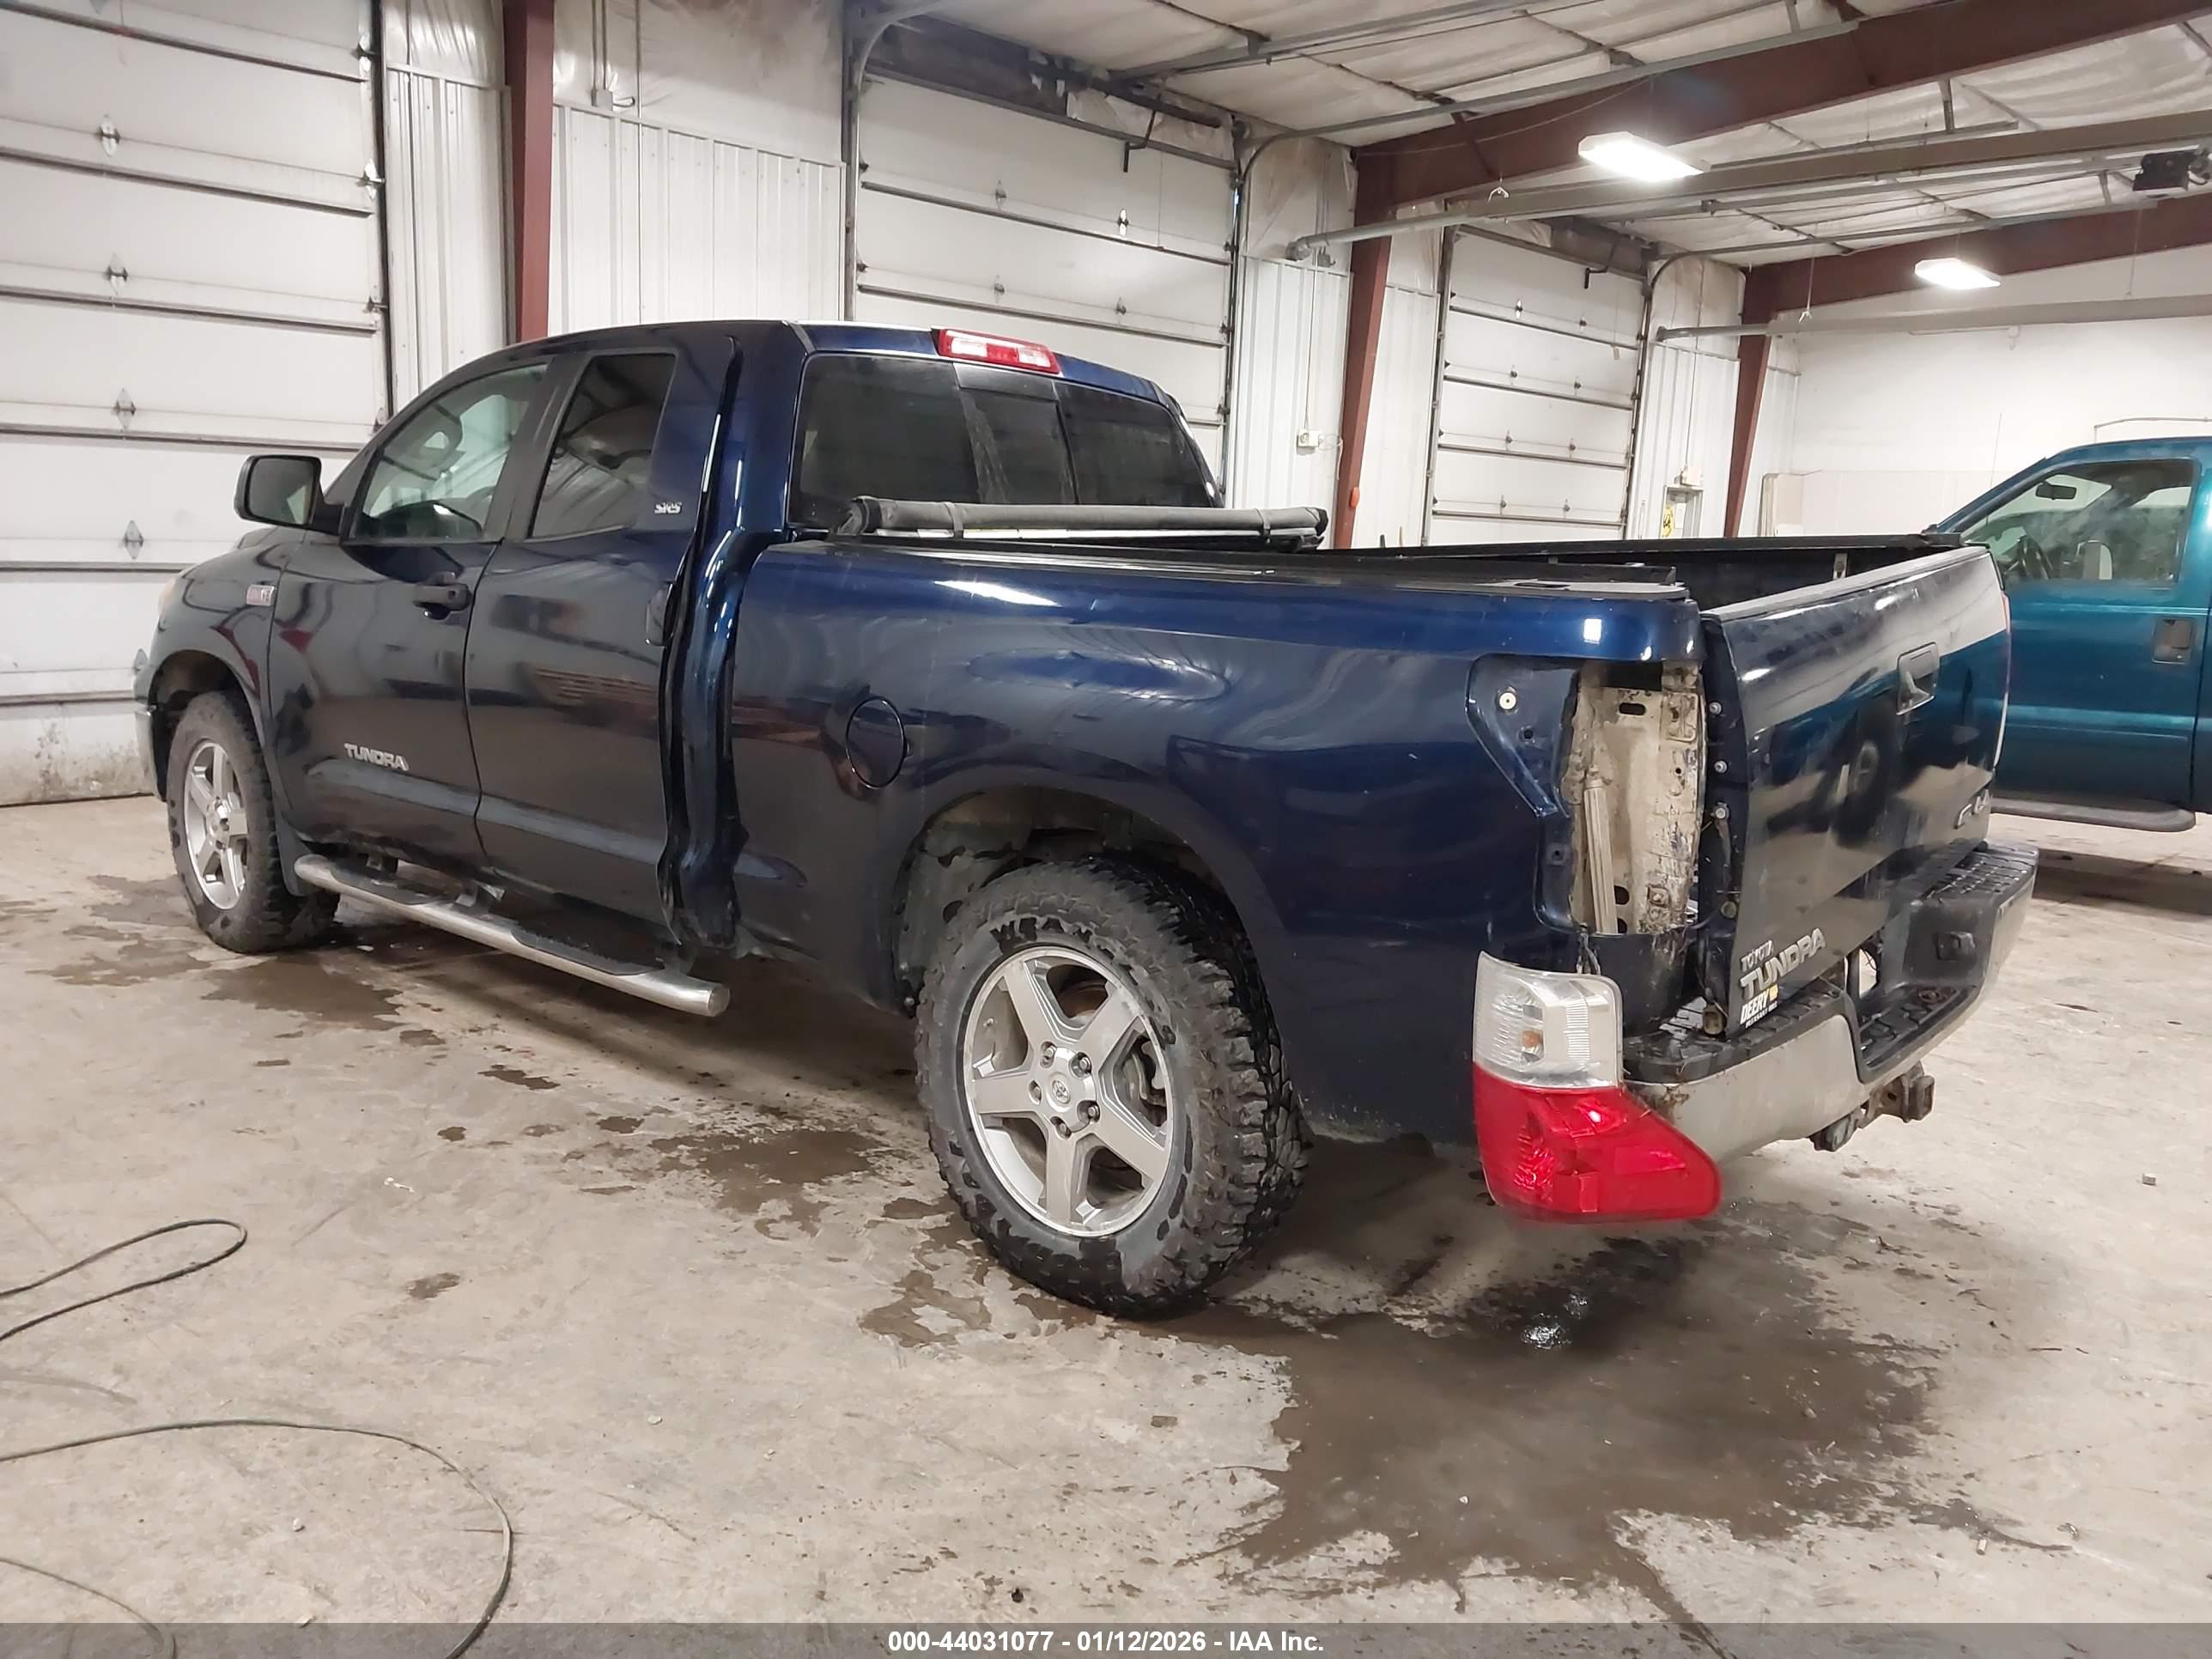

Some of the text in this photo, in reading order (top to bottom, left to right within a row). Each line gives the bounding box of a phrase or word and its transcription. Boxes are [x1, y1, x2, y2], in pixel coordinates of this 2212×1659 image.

[343, 742, 410, 771] TUNDRA
[1740, 939, 1774, 972] TOYOTA
[1740, 927, 1826, 1001] TUNDRA
[1740, 988, 1769, 1025] DEERY
